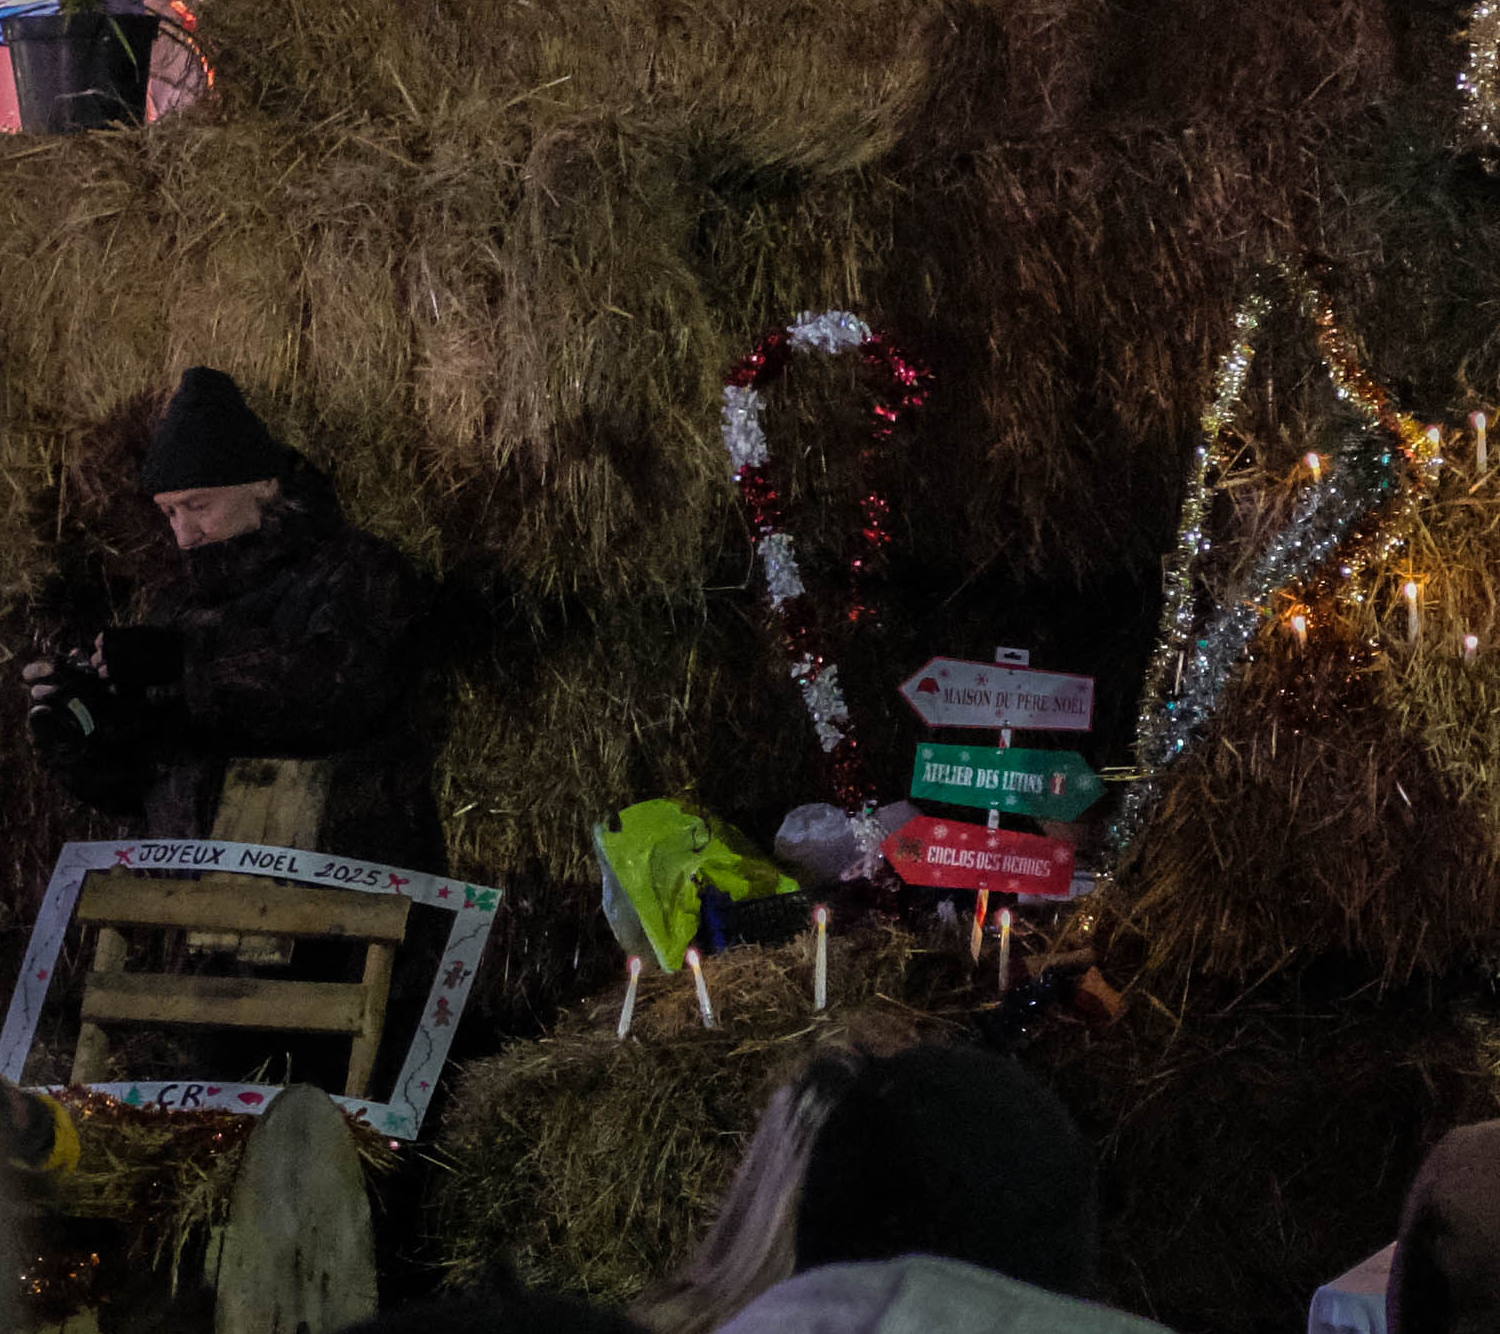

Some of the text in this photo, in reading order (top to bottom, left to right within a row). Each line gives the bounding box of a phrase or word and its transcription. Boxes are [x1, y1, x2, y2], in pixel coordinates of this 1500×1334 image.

[943, 687, 992, 707] MAISON
[996, 691, 1013, 708] DU
[922, 762, 1044, 794] ATELIER DES LUTINS
[139, 844, 226, 864] JOYEUX
[314, 862, 382, 886] 2025
[927, 846, 1051, 877] ENCLOS DES RENNES
[157, 1083, 204, 1107] CR
